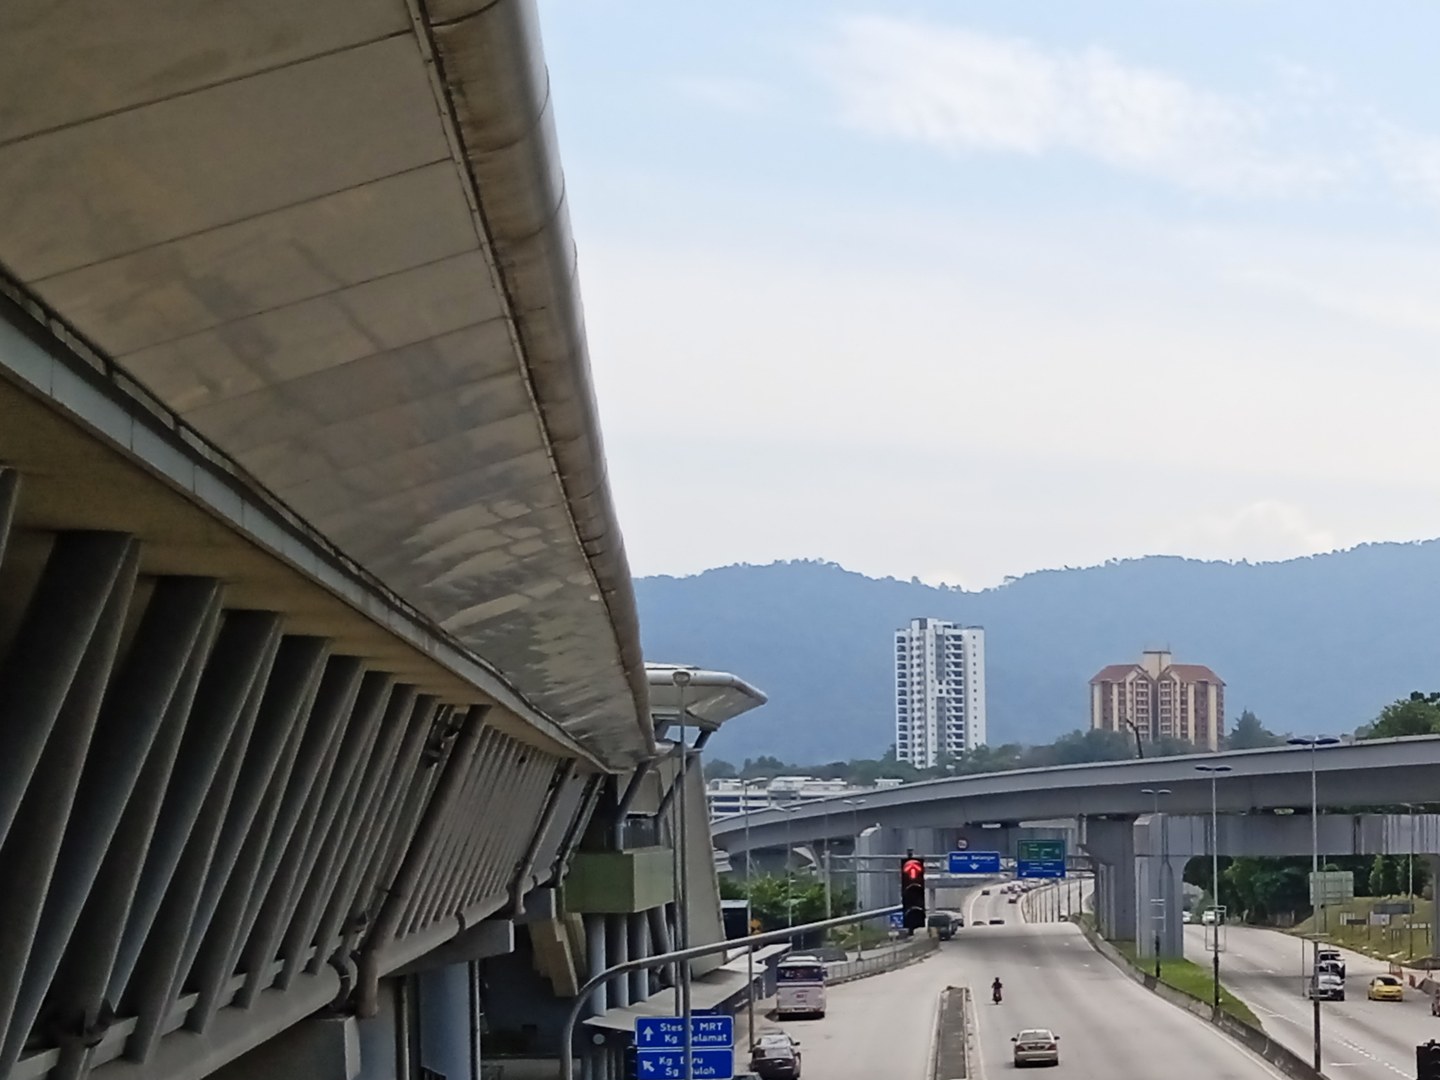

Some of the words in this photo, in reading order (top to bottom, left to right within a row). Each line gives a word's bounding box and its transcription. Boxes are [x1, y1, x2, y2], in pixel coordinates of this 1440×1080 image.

[660, 1022, 694, 1031] Stesn
[699, 1022, 723, 1031] MRT
[664, 1034, 678, 1044] Kg
[690, 1033, 727, 1042] elamat
[659, 1056, 673, 1065] Kg
[680, 1056, 703, 1064] ru
[665, 1067, 679, 1077] Sg
[691, 1066, 716, 1075] uloh
